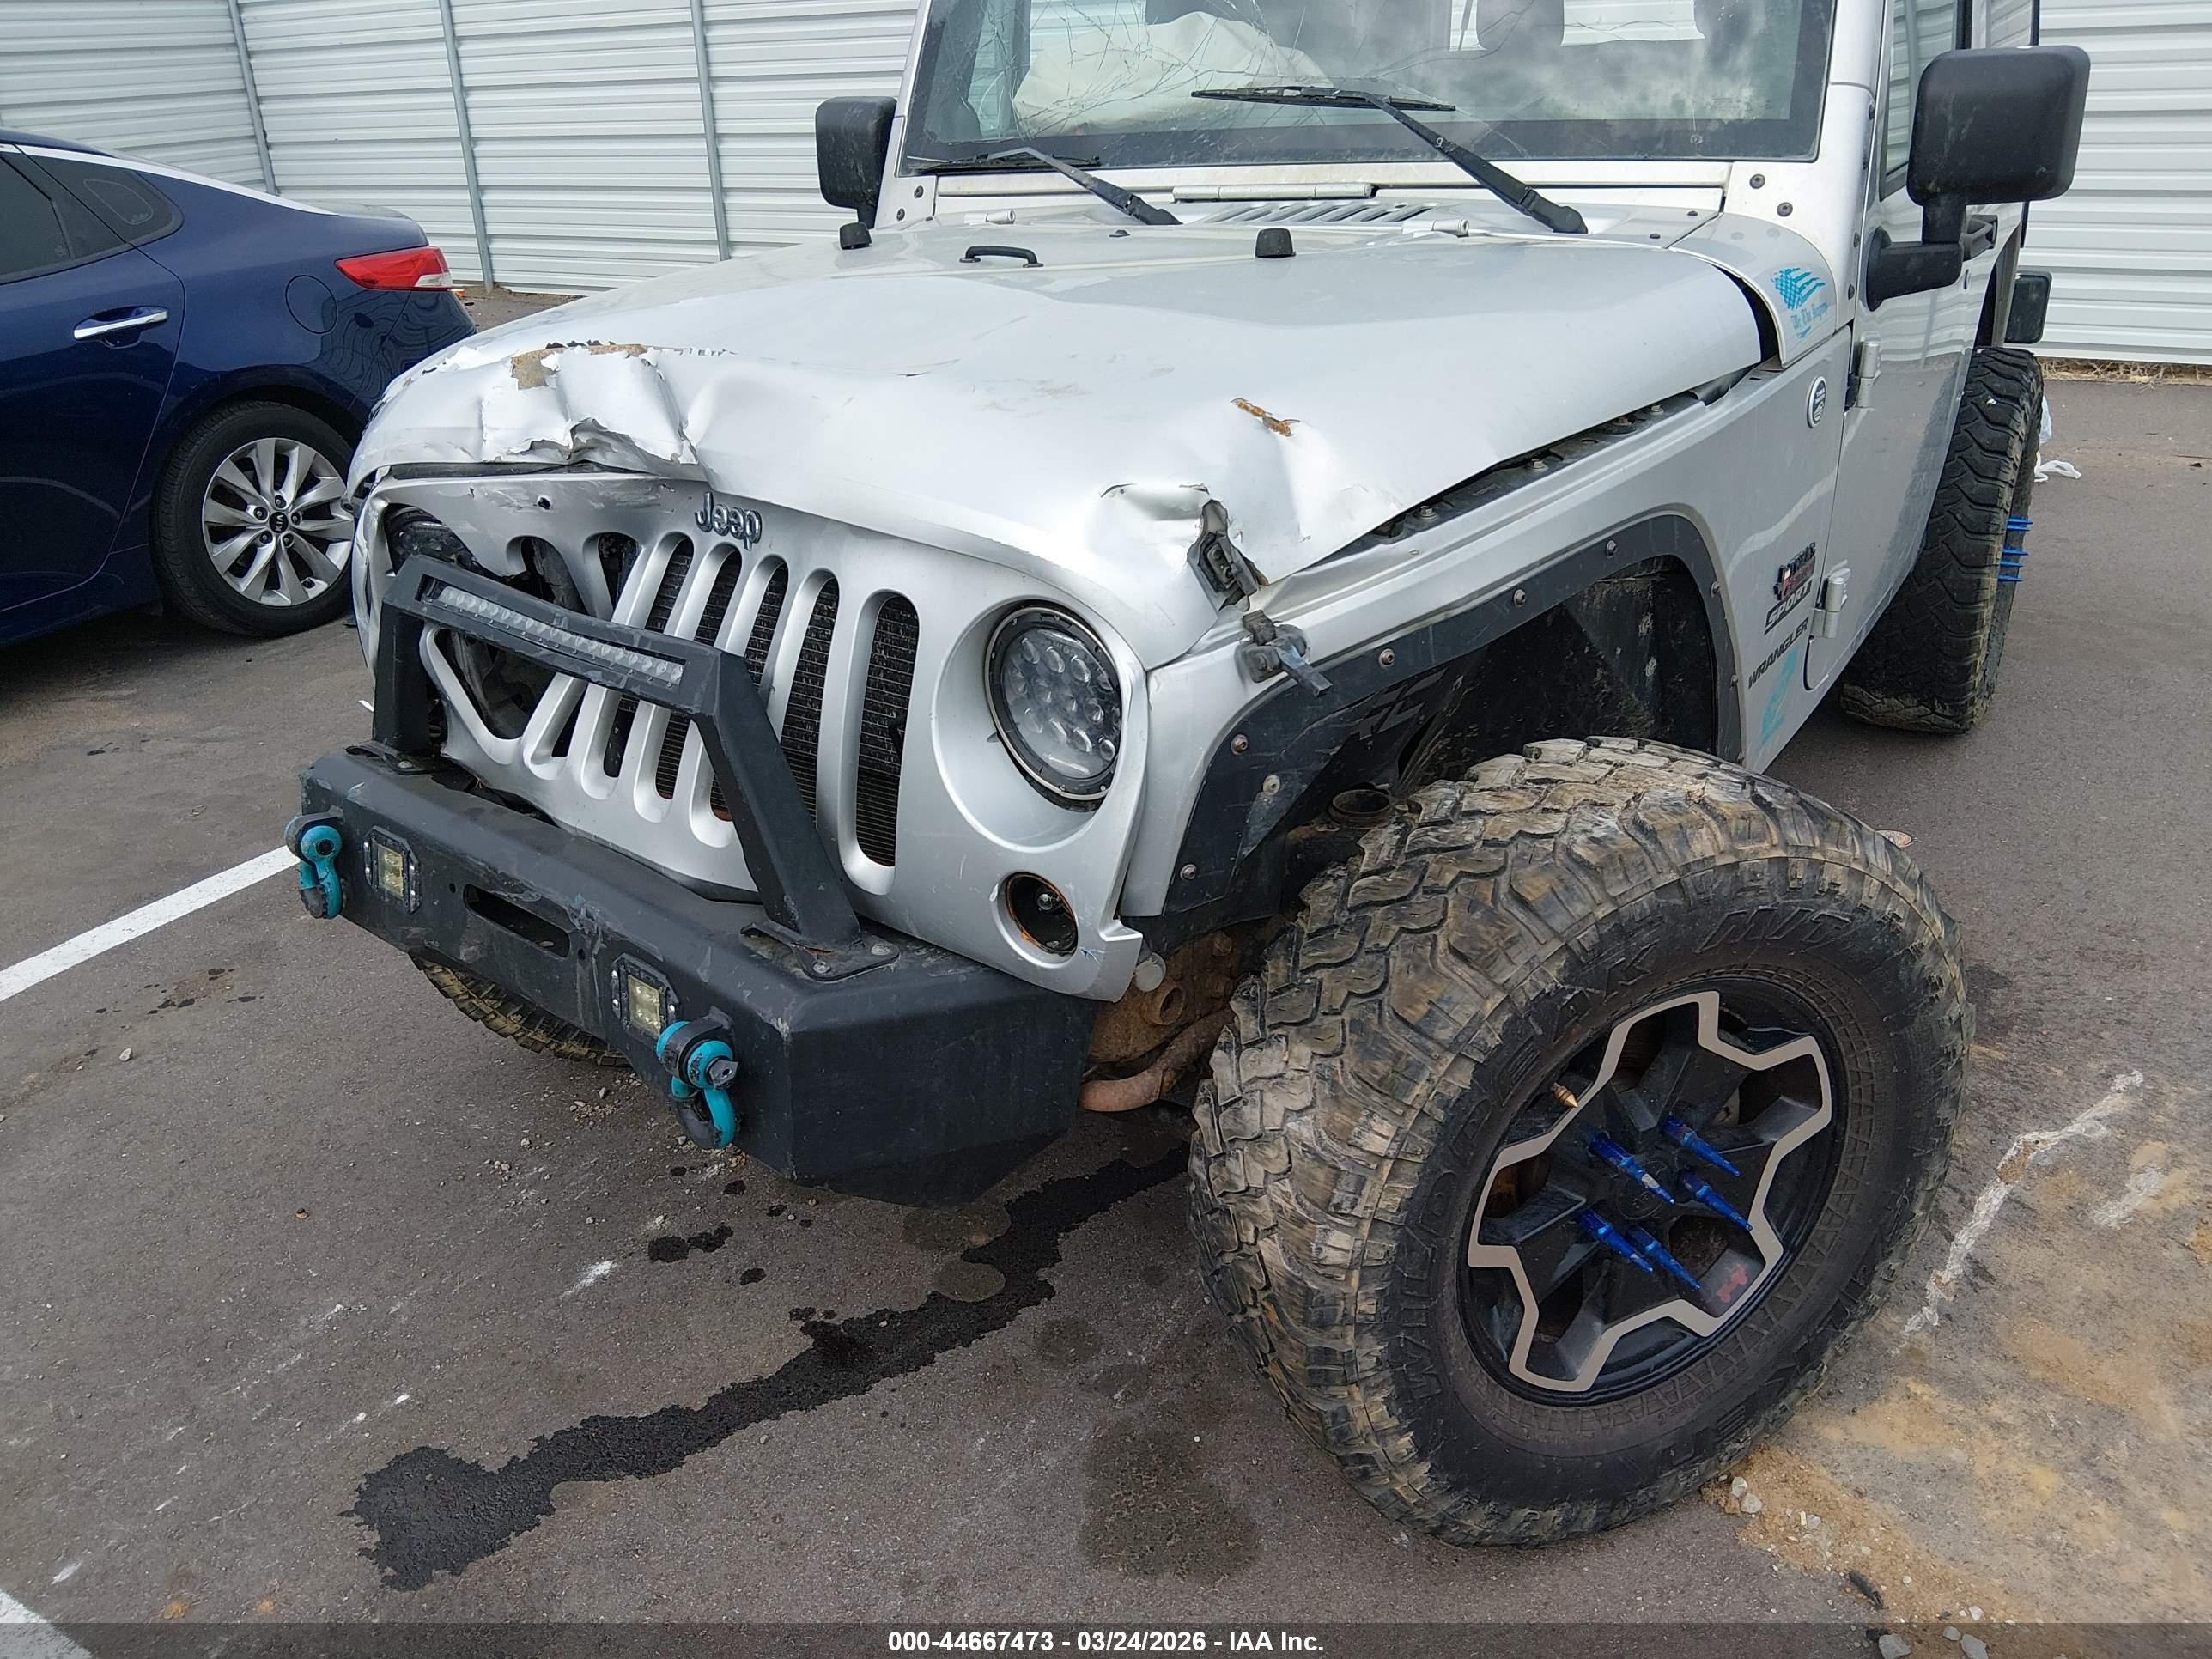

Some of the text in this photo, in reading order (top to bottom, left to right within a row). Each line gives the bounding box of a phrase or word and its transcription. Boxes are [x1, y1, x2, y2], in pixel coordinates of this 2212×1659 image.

[695, 491, 762, 550] Jeep
[1765, 580, 1812, 627] SPORT
[1748, 617, 1809, 688] WRANGLER
[1400, 939, 1660, 1403] WILDPEAK
